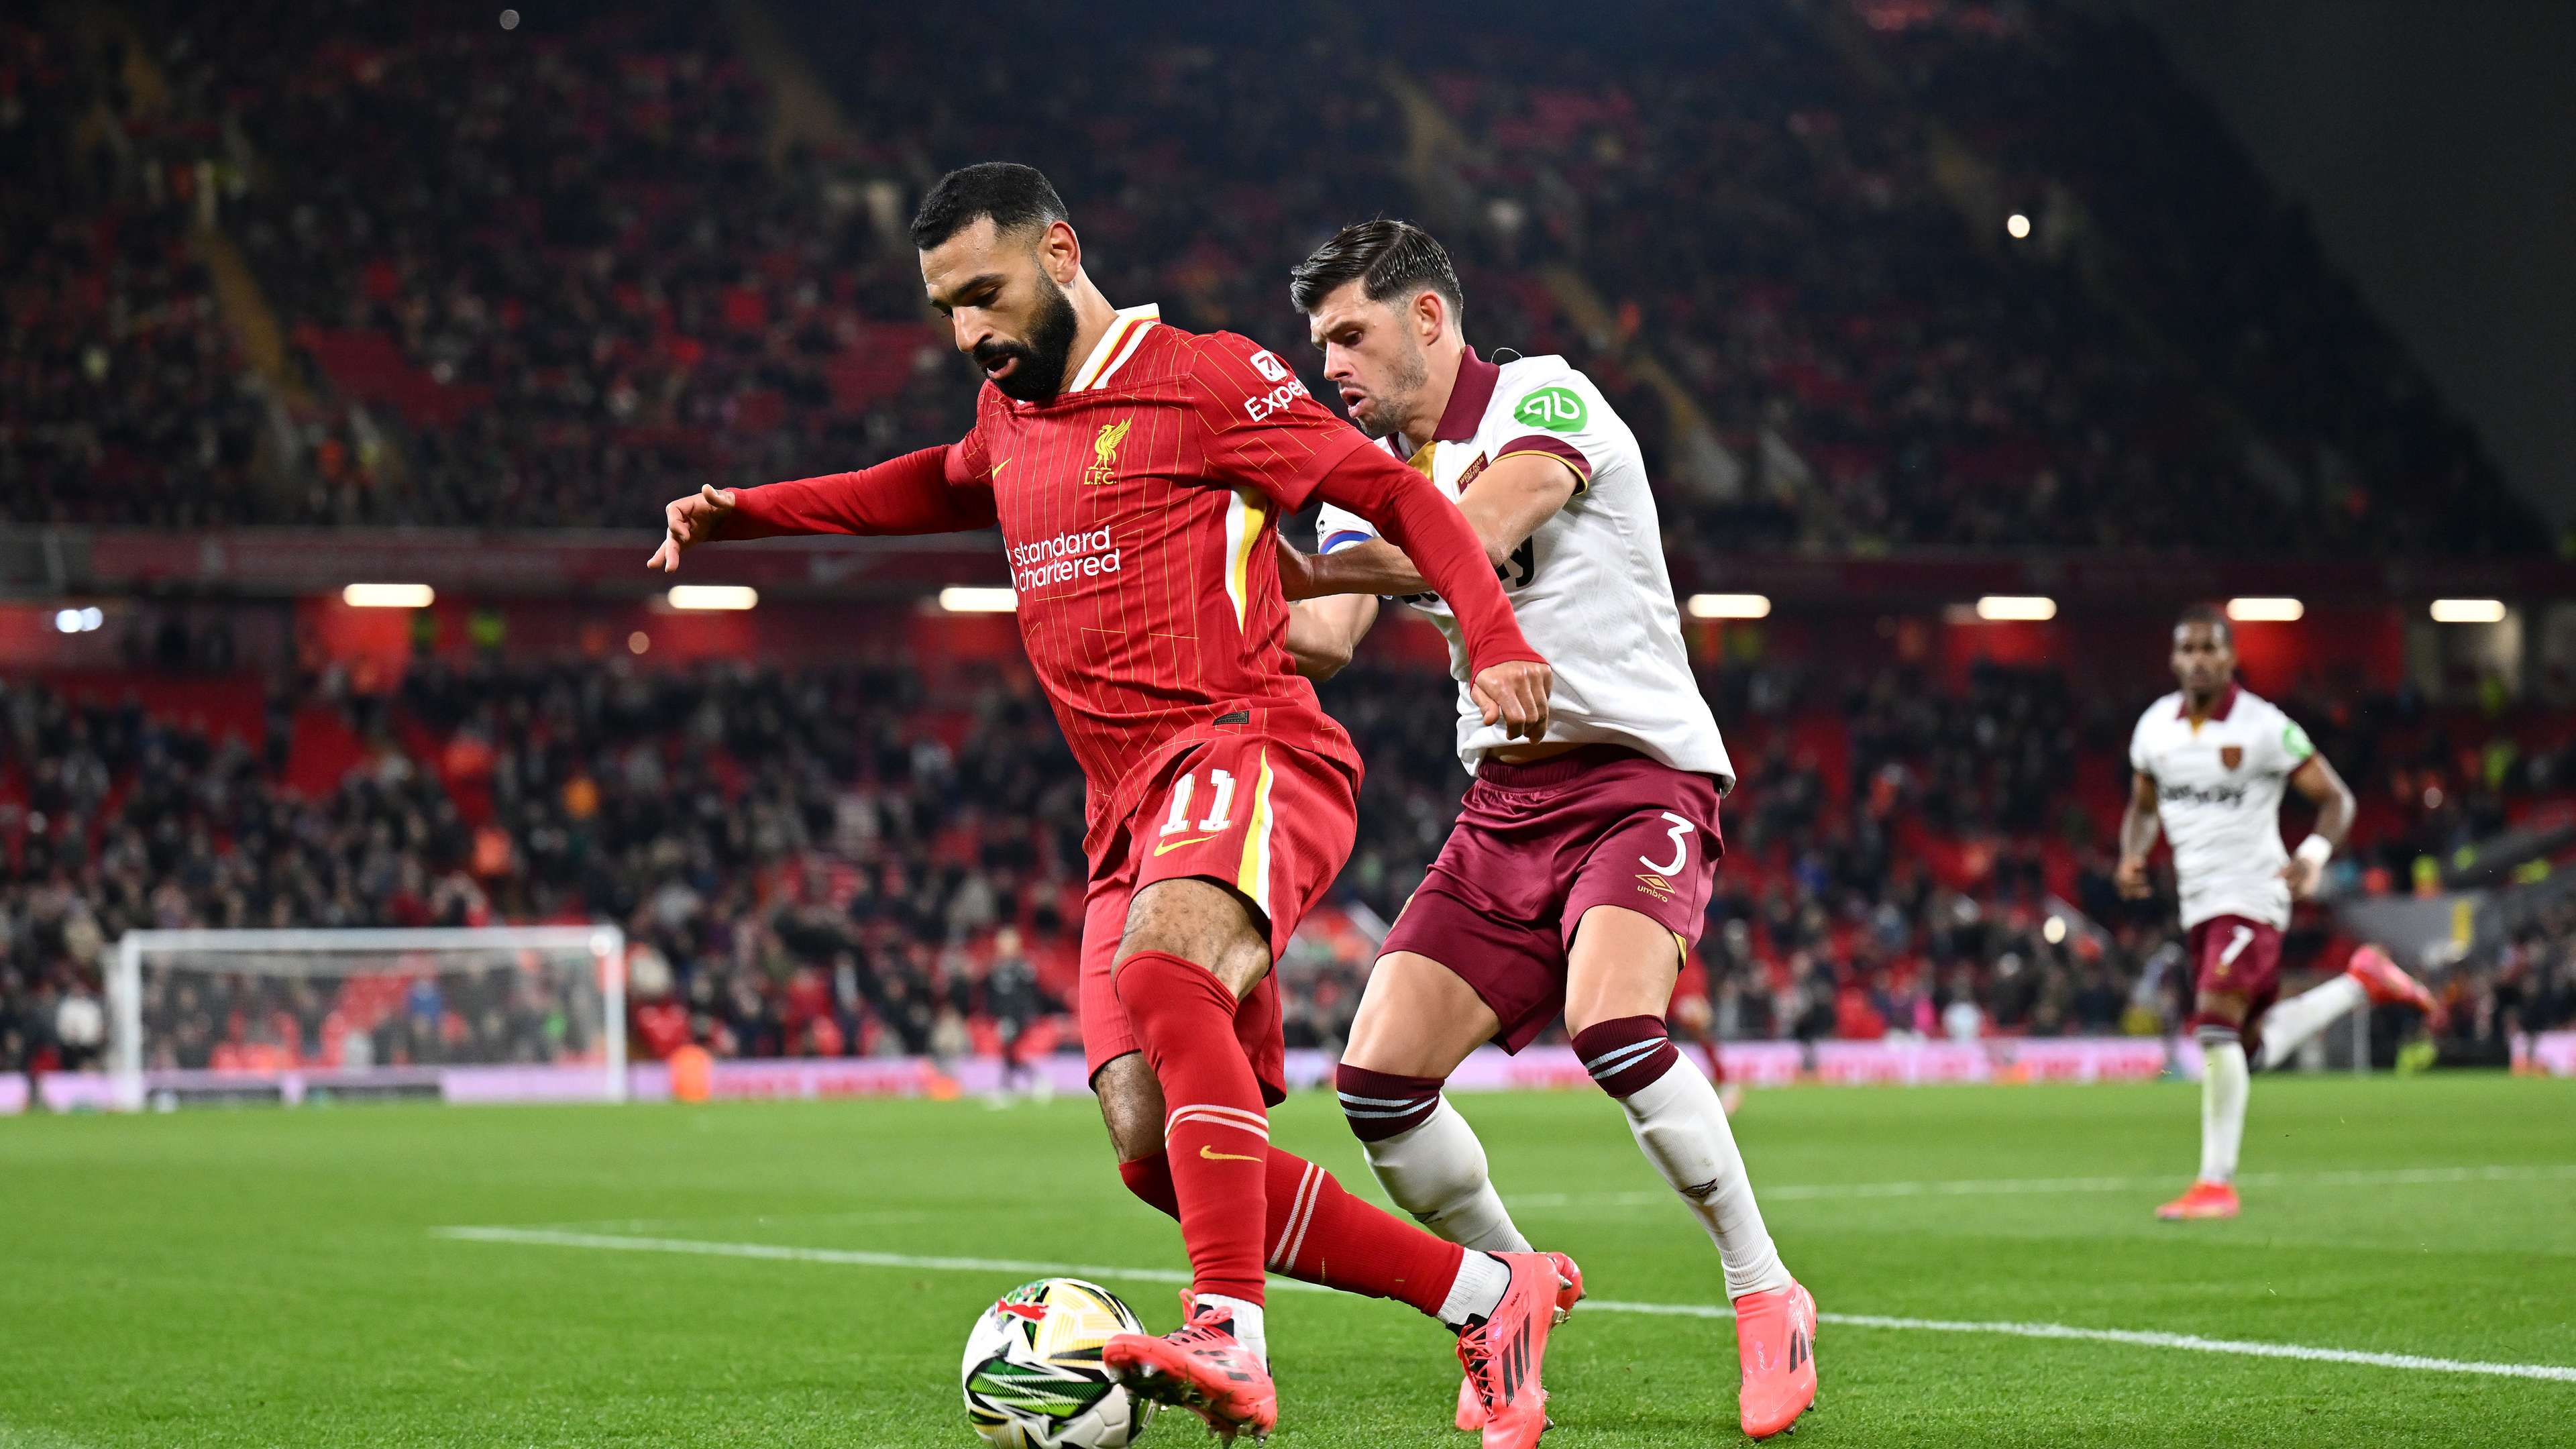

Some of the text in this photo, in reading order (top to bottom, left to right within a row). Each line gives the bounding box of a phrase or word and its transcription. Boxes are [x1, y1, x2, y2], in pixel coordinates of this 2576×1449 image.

[1459, 455, 1485, 484] WEST HAM
[1464, 466, 1481, 483] UNITED
[1014, 525, 1110, 567] standard
[1019, 548, 1121, 592] chartered
[1159, 769, 1236, 837] 11
[1639, 811, 1695, 876] 3
[1637, 885, 1668, 903] umbro
[2220, 924, 2255, 966] 7
